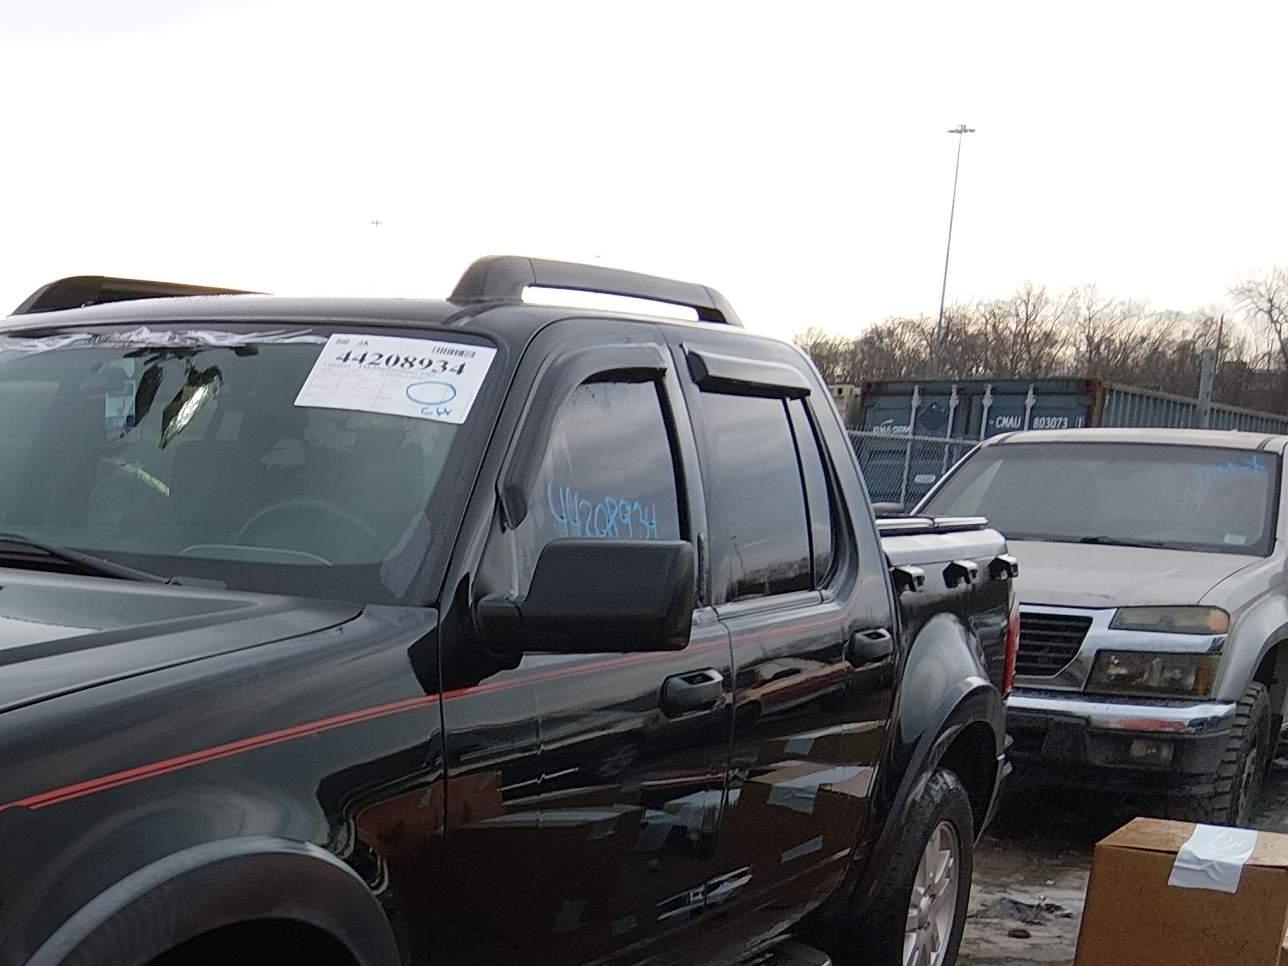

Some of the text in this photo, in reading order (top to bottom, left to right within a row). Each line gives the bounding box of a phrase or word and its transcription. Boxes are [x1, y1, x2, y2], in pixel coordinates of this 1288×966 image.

[336, 350, 466, 376] 44208934
[996, 416, 1022, 428] CMAU
[1033, 416, 1069, 429] 803073
[547, 480, 658, 540] 44208934
